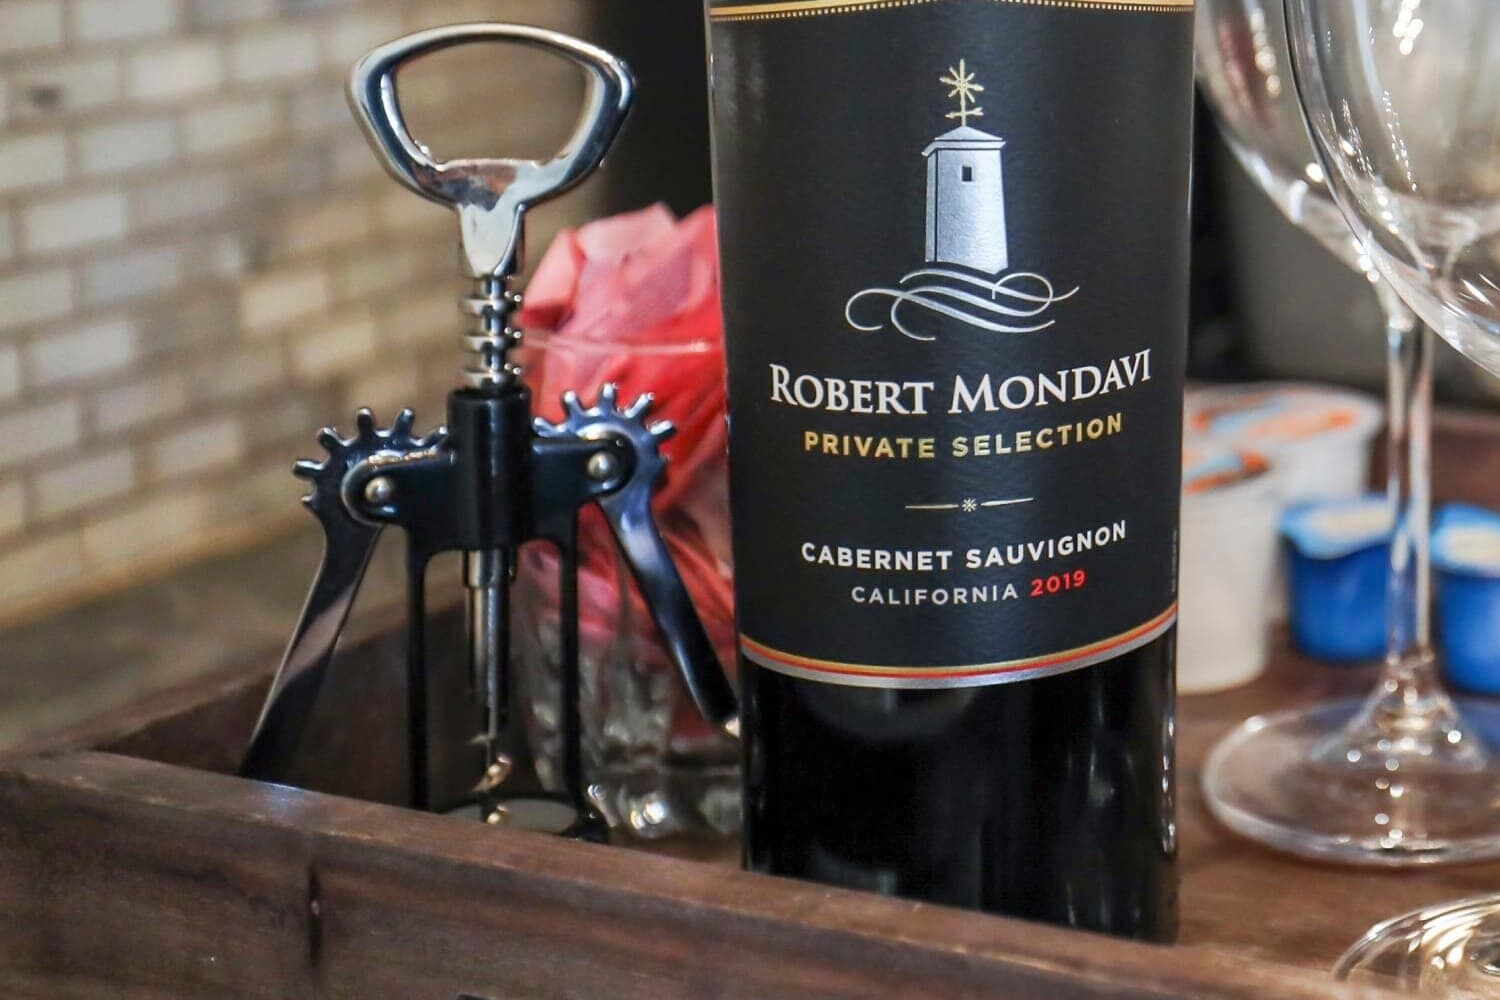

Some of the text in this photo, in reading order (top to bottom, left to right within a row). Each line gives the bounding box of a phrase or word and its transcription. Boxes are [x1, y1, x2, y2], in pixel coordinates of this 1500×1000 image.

[769, 349, 1151, 414] ROBERT MONDAVI
[804, 413, 1123, 459] PRIVATE SELECTION
[801, 542, 953, 571] CABERNET
[966, 520, 1126, 568] SAUVIGNON
[851, 569, 1086, 606] CALIFORNIA 2019
